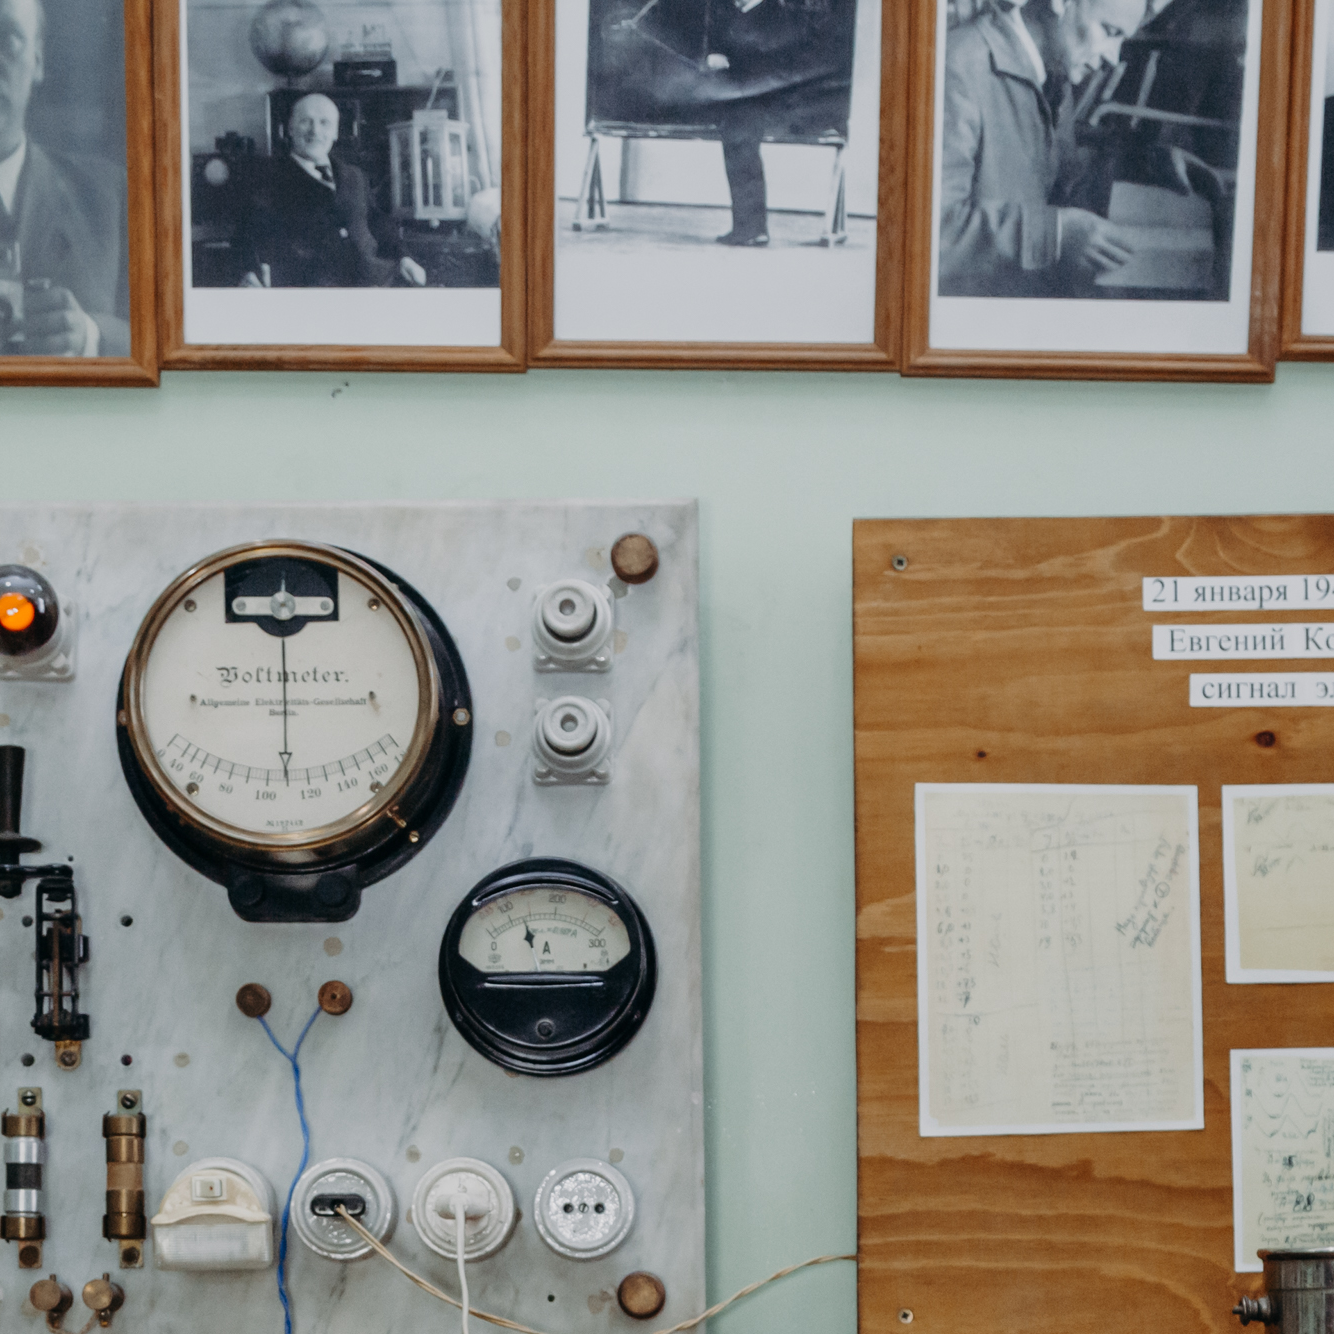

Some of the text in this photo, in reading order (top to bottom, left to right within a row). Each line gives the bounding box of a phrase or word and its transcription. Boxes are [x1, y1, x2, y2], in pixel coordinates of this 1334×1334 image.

[1151, 578, 1180, 602] 21
[1193, 582, 1288, 609] января
[1168, 627, 1286, 652] Евгений
[1201, 679, 1297, 699] сигнал
[168, 758, 184, 773] 40
[367, 763, 389, 781] 160
[189, 771, 205, 784] 60
[218, 783, 234, 795] 80
[336, 777, 359, 793] 140
[255, 789, 277, 801] 100
[300, 787, 323, 800] 120
[548, 894, 567, 904] 200
[498, 902, 514, 914] 100
[490, 941, 498, 951] 0
[542, 940, 551, 955] A
[588, 938, 606, 948] 300
